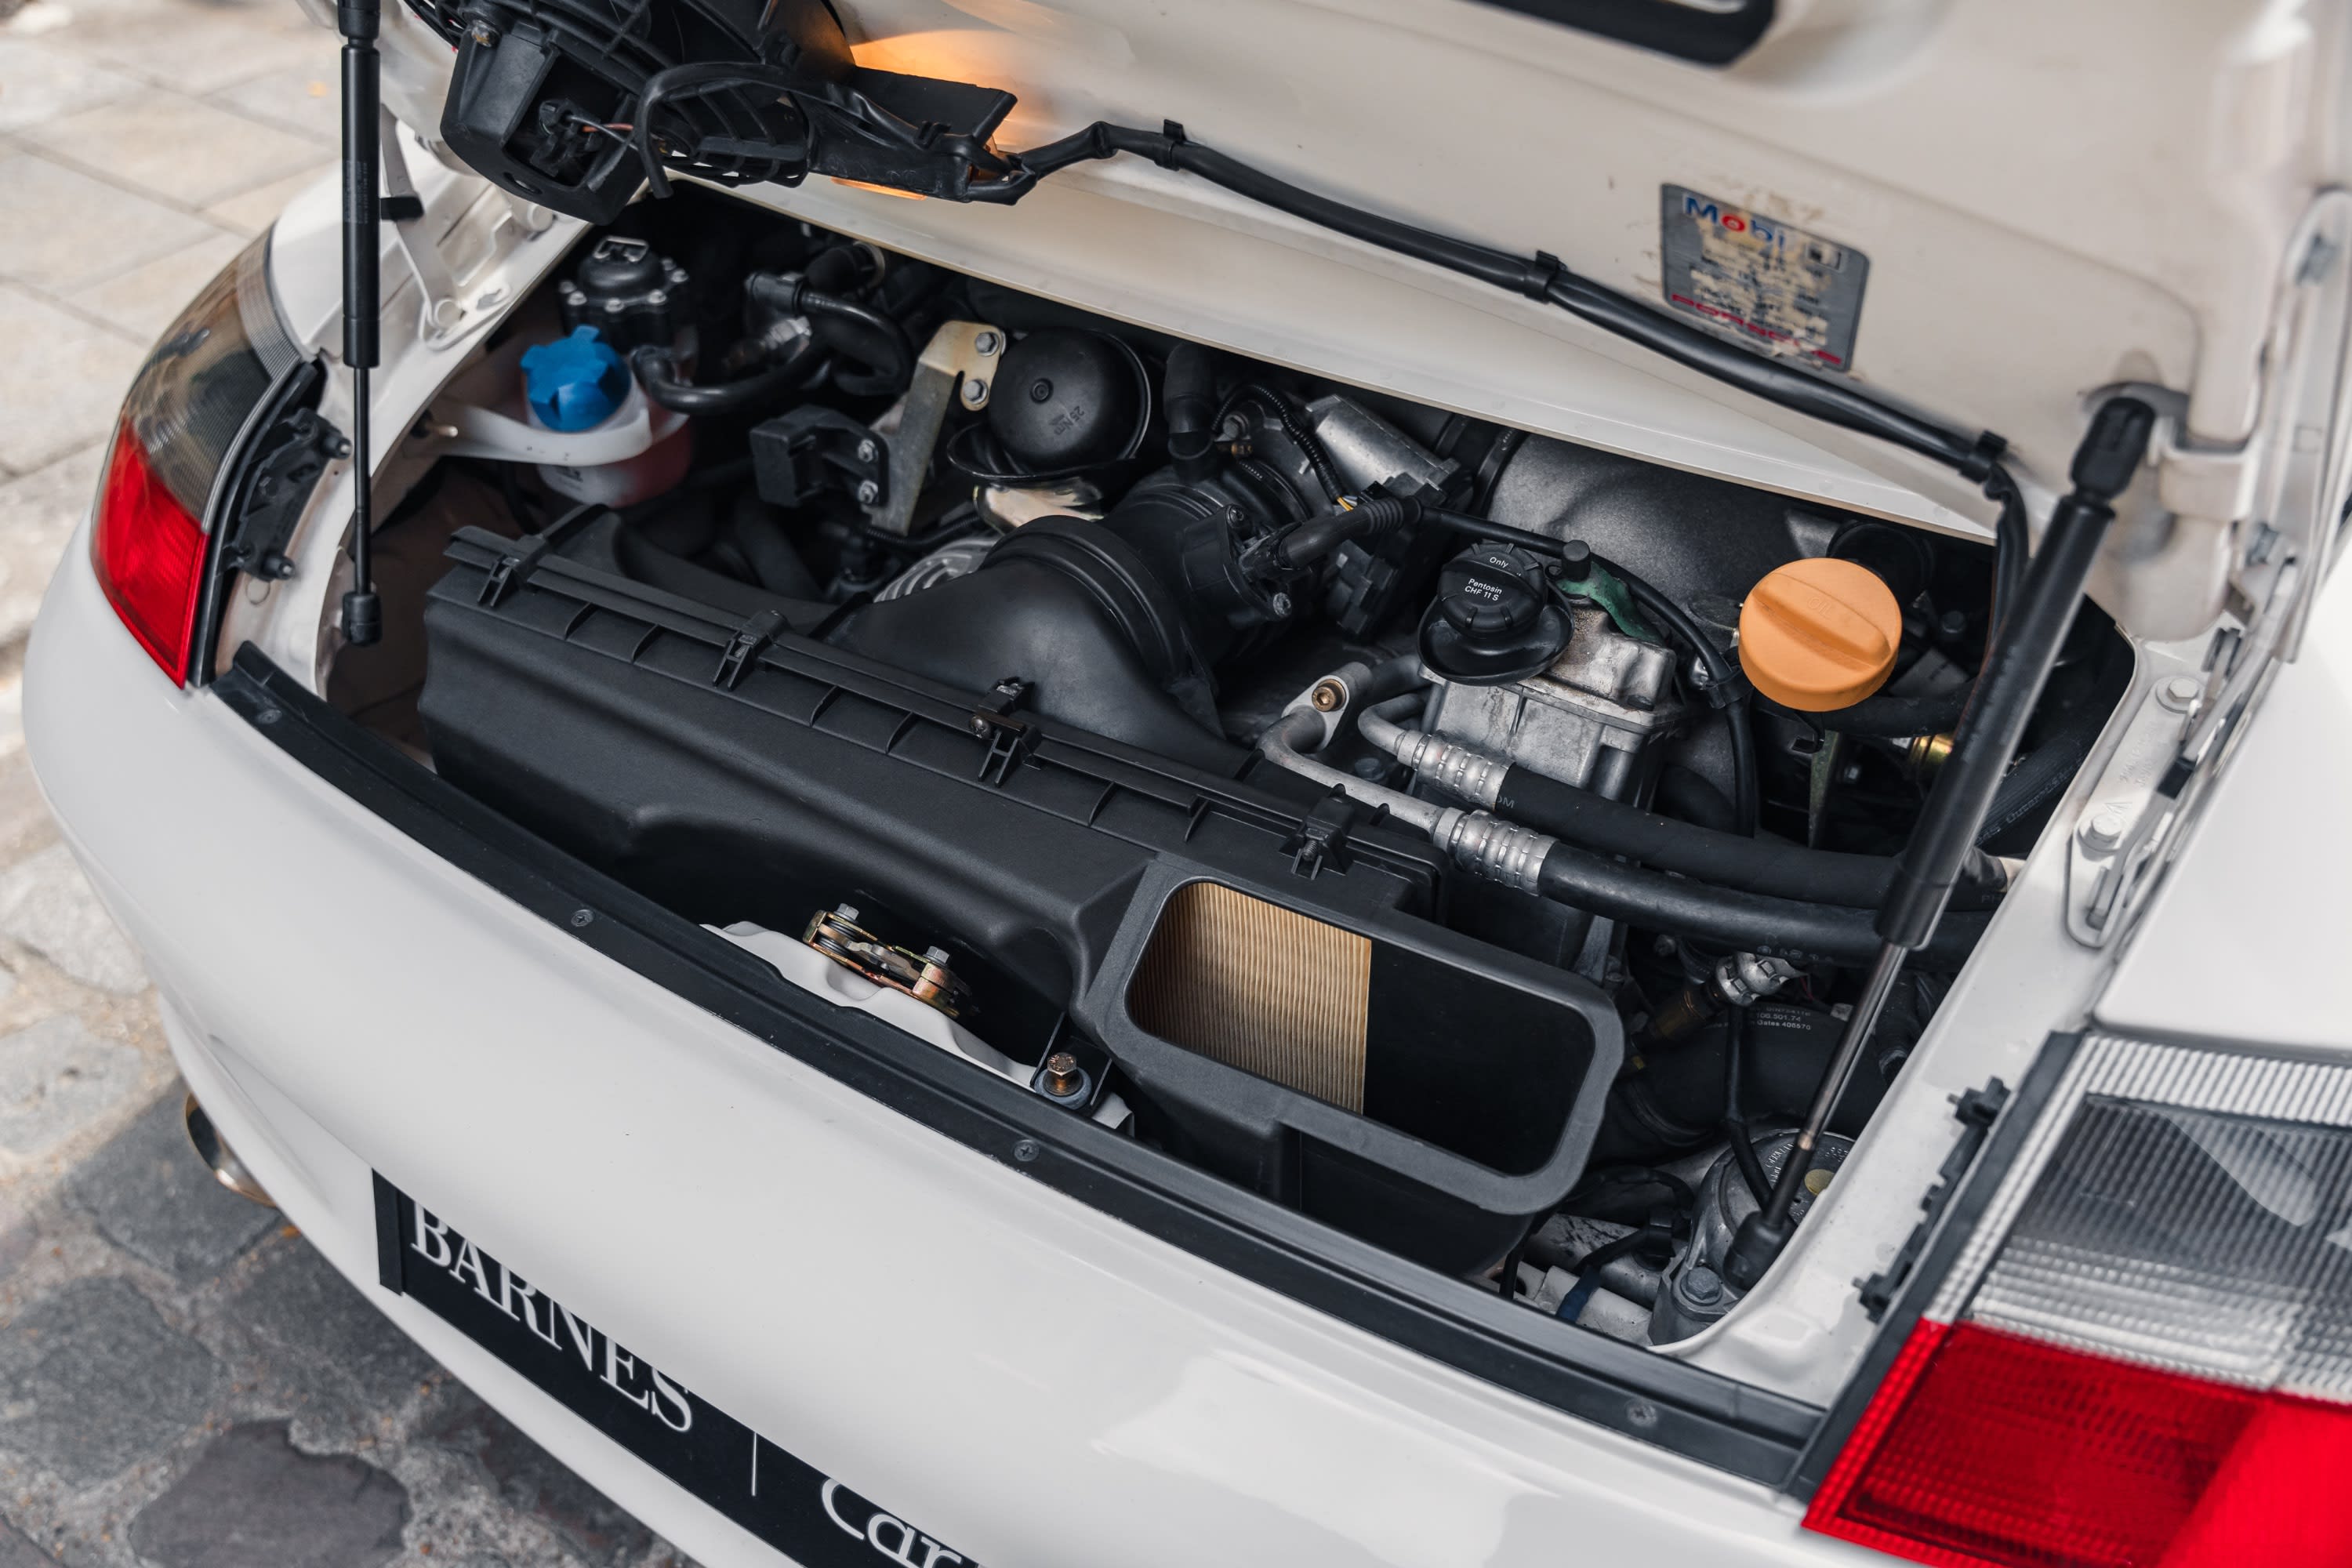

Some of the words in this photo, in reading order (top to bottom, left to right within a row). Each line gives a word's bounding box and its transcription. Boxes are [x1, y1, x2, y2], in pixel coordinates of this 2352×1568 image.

[1490, 557, 1509, 568] Only
[1465, 586, 1483, 595] CHF
[1468, 578, 1502, 594] Pentosin
[411, 1200, 693, 1432] BARNES
